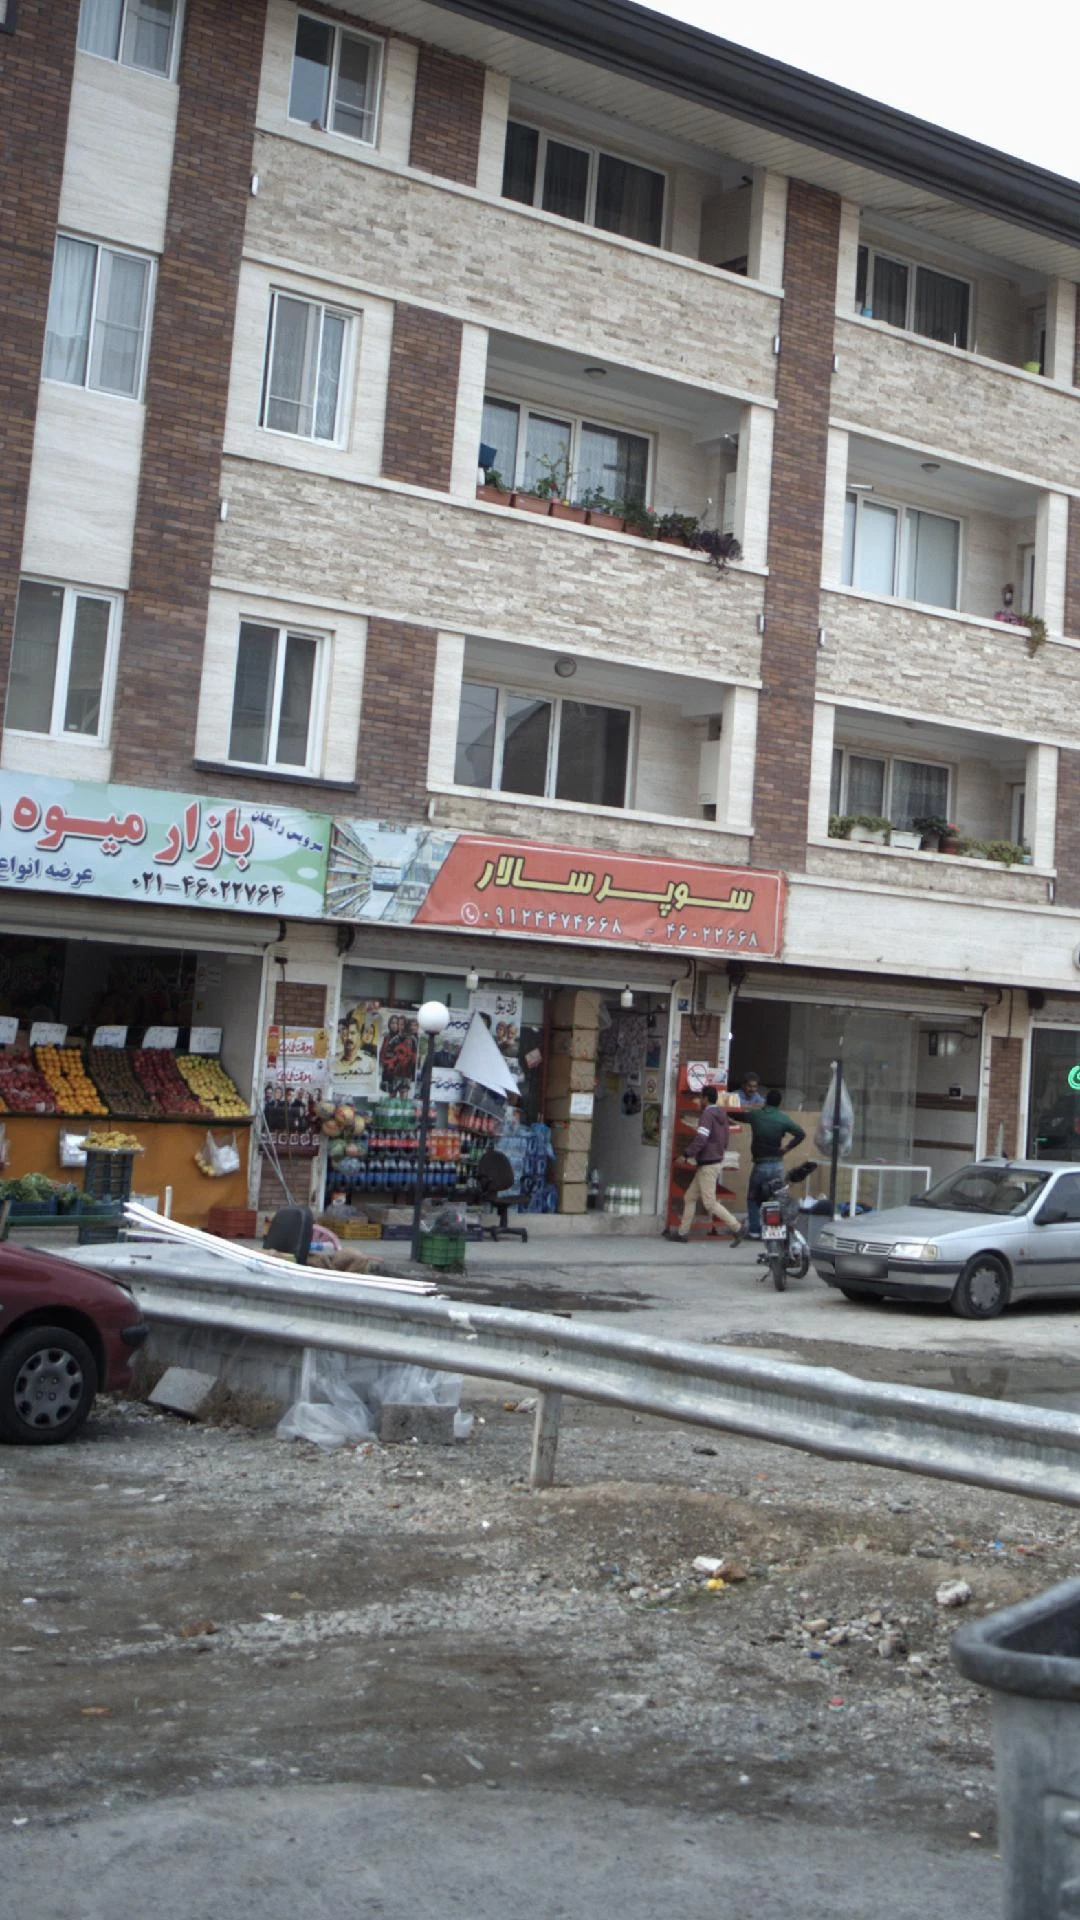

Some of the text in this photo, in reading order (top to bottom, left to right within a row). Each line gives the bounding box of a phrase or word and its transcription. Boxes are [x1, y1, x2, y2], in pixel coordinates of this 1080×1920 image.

[12, 795, 253, 871] بازار میوه
[45, 861, 93, 887] عرضه
[474, 854, 756, 919] سوپر سالار
